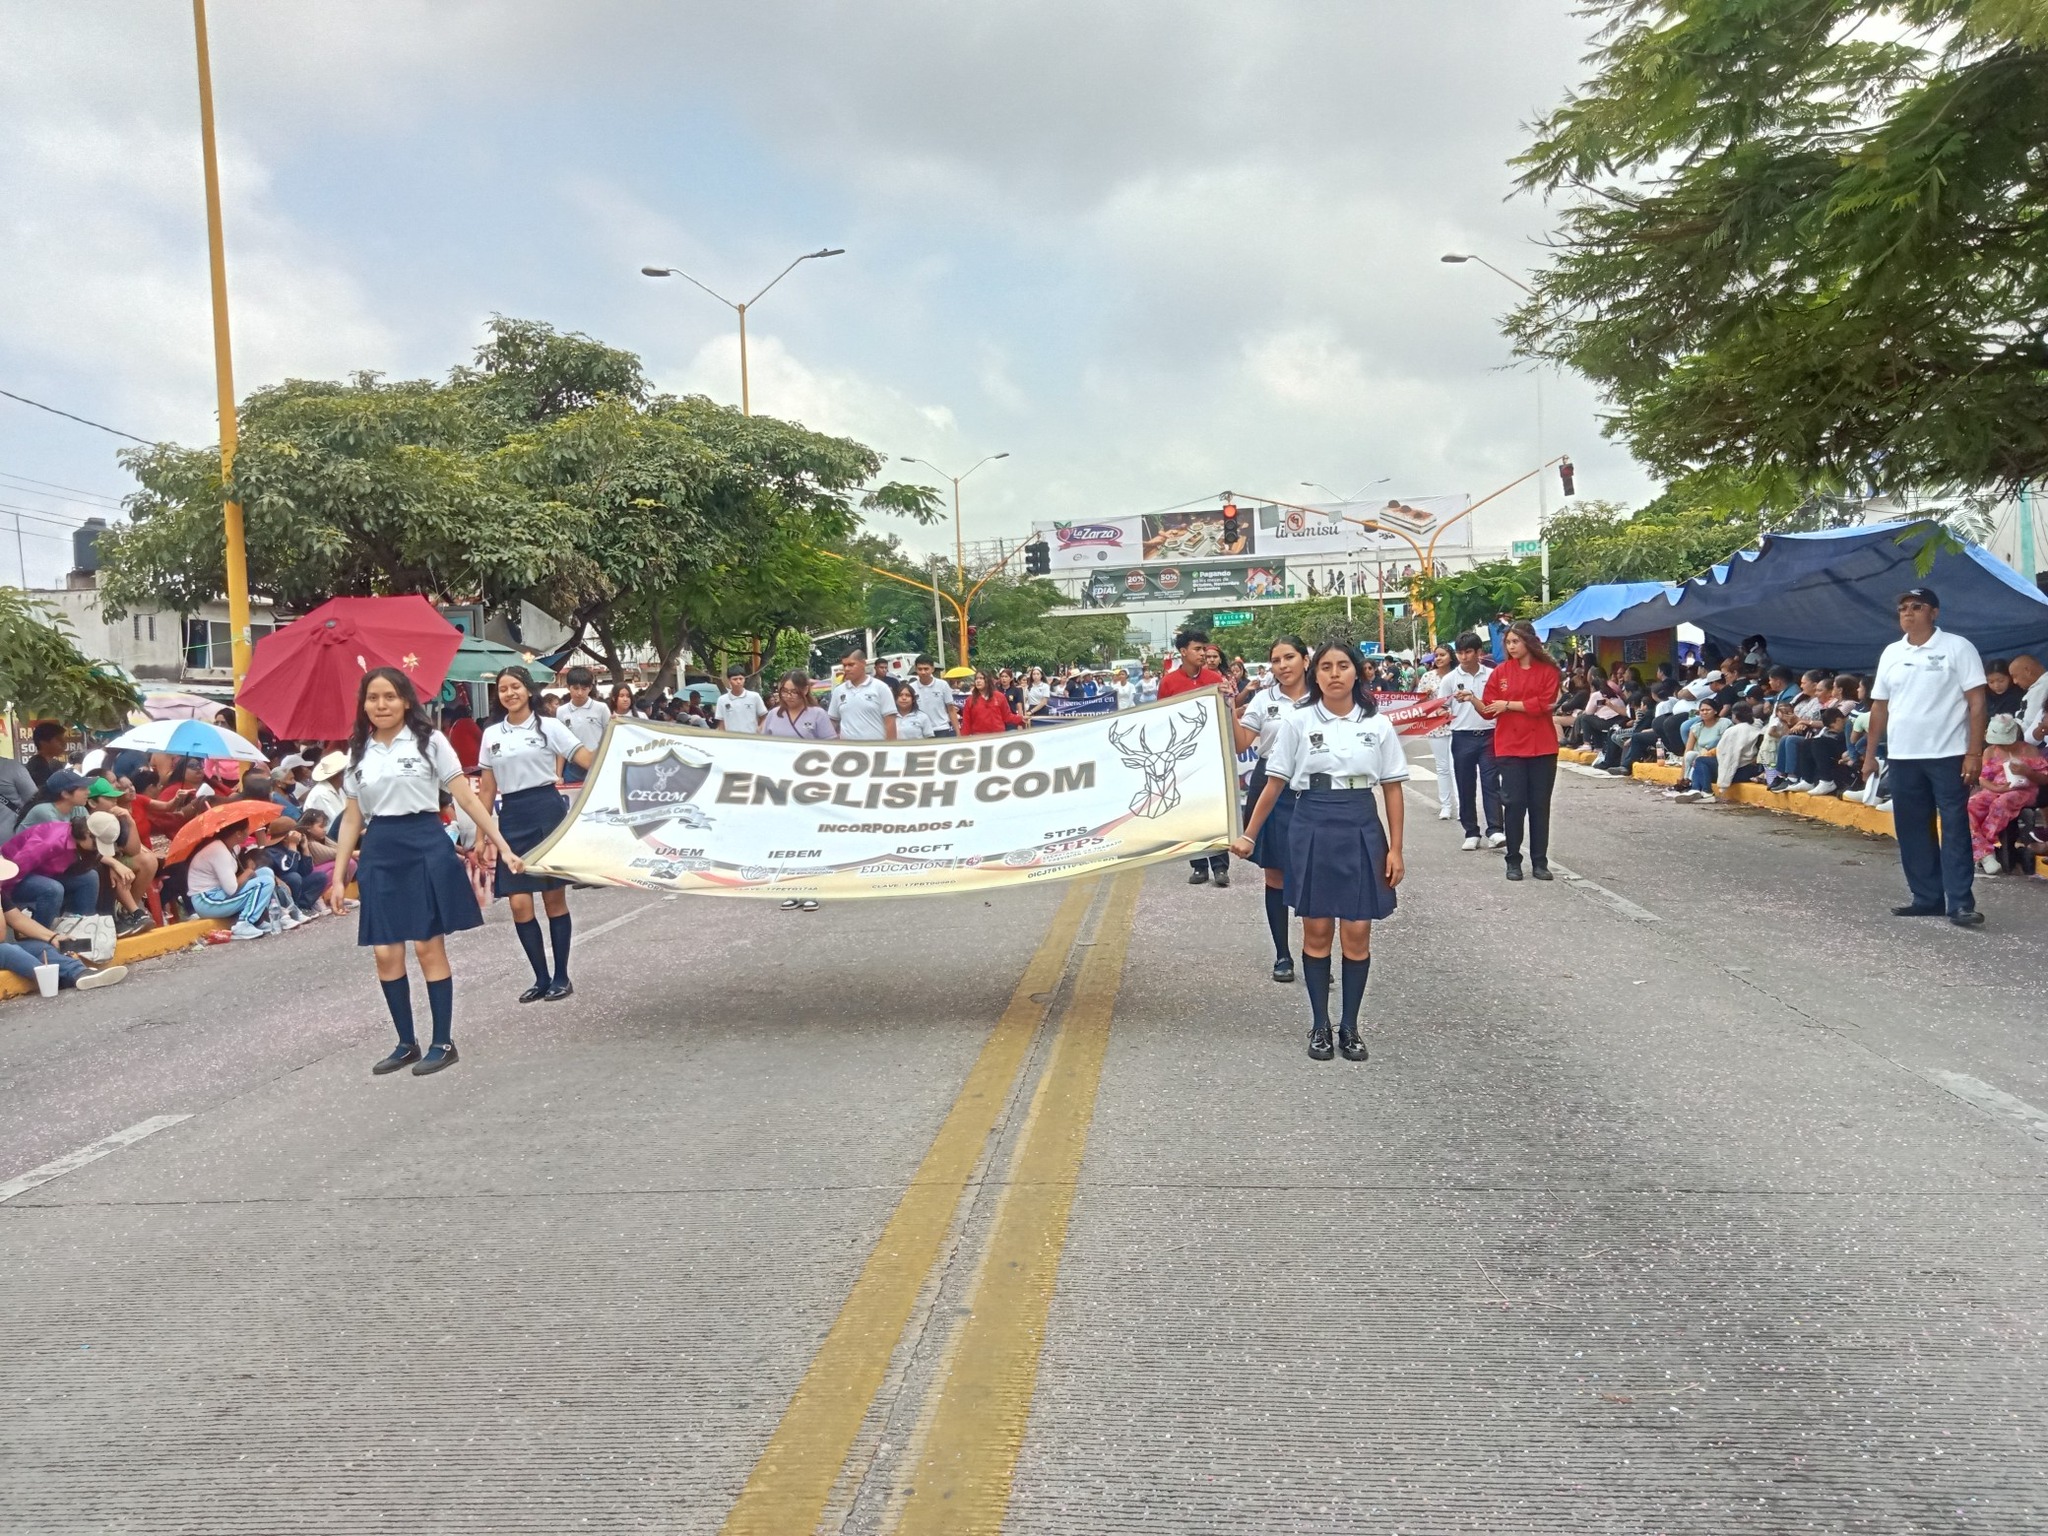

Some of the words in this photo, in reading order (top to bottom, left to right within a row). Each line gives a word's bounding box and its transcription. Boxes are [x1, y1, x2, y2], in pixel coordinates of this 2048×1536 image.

[1082, 528, 1115, 540] Zarza
[1199, 571, 1232, 579] Pagando
[793, 740, 1035, 777] COLEGIO
[715, 772, 958, 809] ENGLISH
[974, 761, 1096, 803] COM
[627, 790, 687, 802] CECOM
[818, 821, 953, 834] INCORPORADOS
[955, 819, 975, 829] A:
[1043, 827, 1088, 839] STPS
[896, 844, 953, 854] DGCFT
[1043, 837, 1105, 854] STPS
[655, 848, 705, 857] UAEM
[768, 850, 822, 858] IEBEM
[860, 861, 945, 874] EDUCACIÓN
